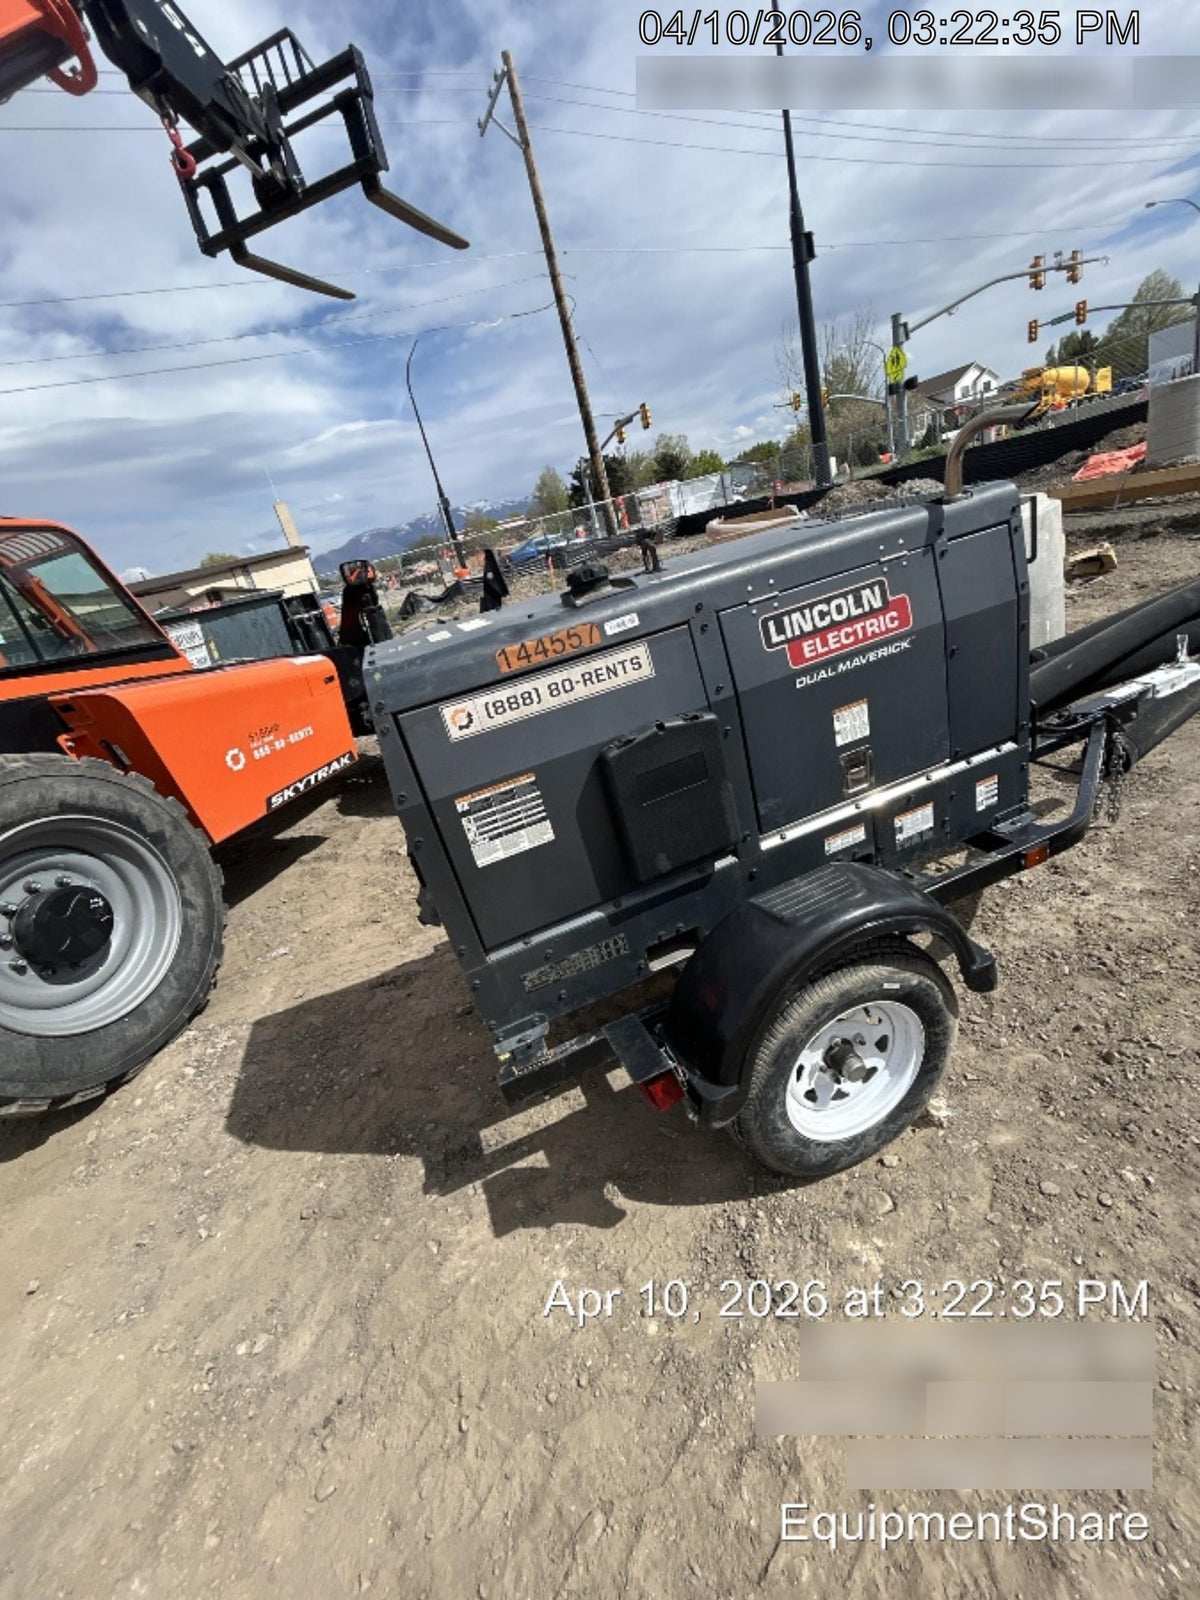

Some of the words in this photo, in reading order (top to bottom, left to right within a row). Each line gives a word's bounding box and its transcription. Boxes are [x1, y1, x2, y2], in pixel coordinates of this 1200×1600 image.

[767, 584, 884, 644] LINCOLN
[801, 610, 900, 659] ELECTRIC
[497, 623, 599, 669] 144557
[796, 667, 836, 688] DUAL
[838, 639, 911, 673] MAVERICK
[484, 686, 543, 719] (888)
[549, 655, 643, 698] 80-RENTS
[270, 753, 351, 808] SKYTRAK
